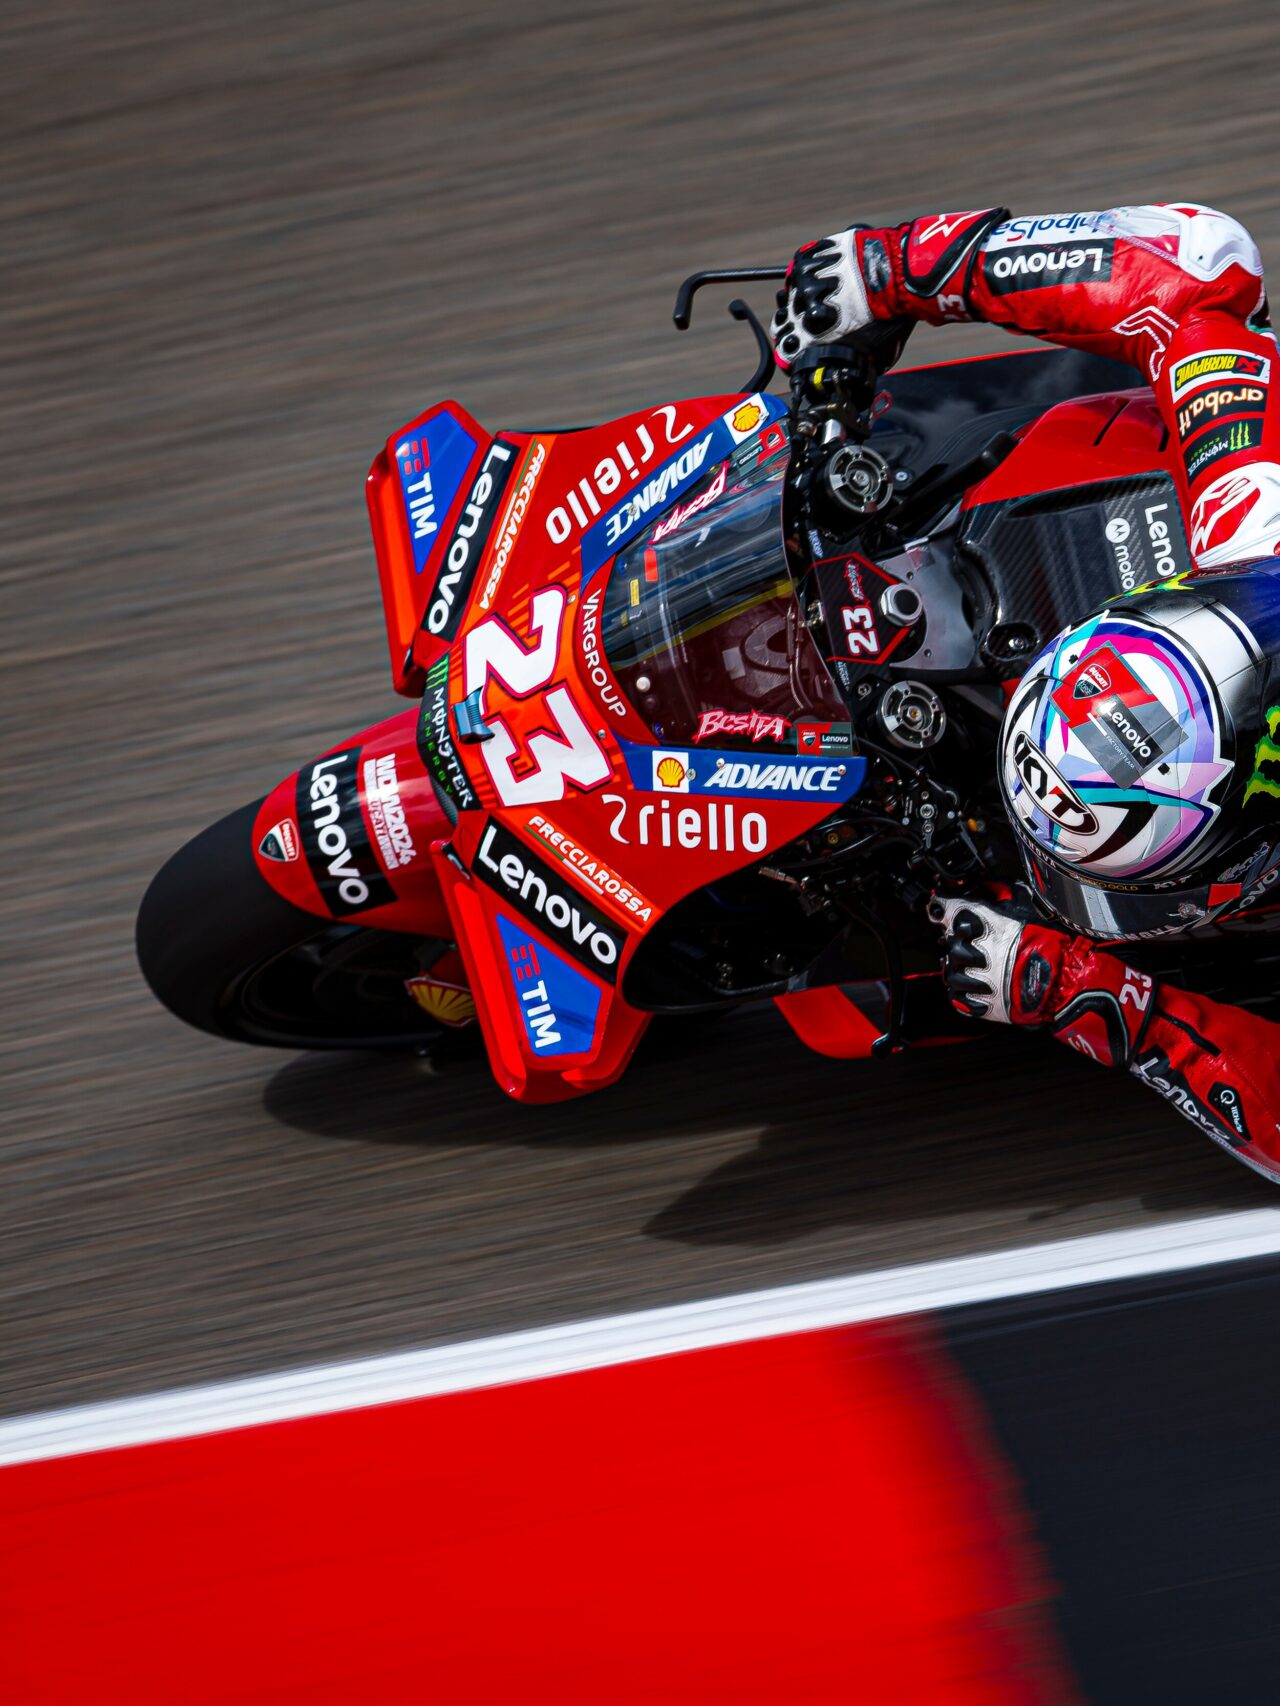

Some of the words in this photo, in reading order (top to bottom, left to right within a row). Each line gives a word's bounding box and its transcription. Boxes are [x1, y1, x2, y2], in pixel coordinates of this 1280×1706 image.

[994, 247, 1103, 278] Lenovo
[1178, 387, 1264, 437] aruba.it
[545, 423, 655, 545] riello
[606, 432, 714, 547] ADVANCE
[1187, 440, 1229, 477] MONSTER
[406, 472, 438, 539] TIM
[427, 444, 511, 634] Lenovo
[479, 443, 546, 610] FRECCIAROSSA
[1145, 503, 1177, 577] Leno
[1115, 546, 1136, 590] moto
[581, 588, 627, 717] VARGROUP
[842, 605, 880, 655] 23
[465, 585, 613, 807] 23
[1088, 665, 1109, 689] DUCATI
[423, 712, 453, 795] ENERGY
[432, 687, 474, 810] MONSTER
[821, 733, 849, 744] Lenovo
[1105, 699, 1153, 760] Lenovo
[704, 762, 841, 792] ADVANCE
[310, 754, 369, 904] Lenovo
[639, 800, 768, 853] riello
[478, 824, 618, 966] Lenovo
[528, 815, 652, 923] FRECCIAROSSA
[522, 980, 562, 1049] TIM
[1119, 967, 1153, 1012] 23
[1139, 1056, 1230, 1141] Lenovo
